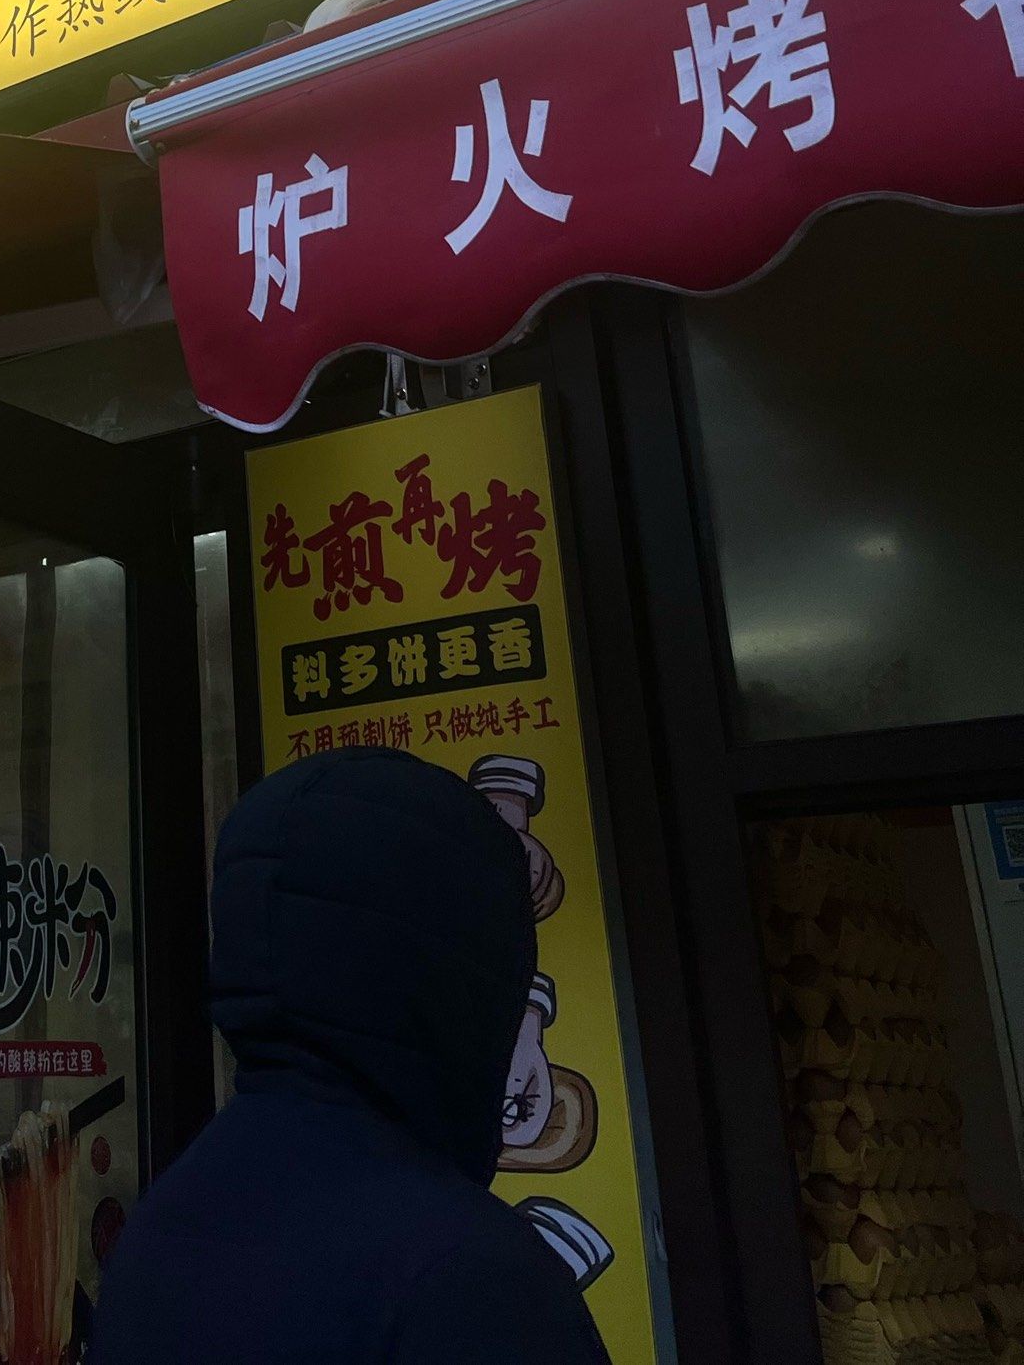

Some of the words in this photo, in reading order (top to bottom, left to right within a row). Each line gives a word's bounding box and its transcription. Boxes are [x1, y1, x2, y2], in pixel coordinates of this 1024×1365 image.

[260, 453, 546, 622] 先煎再烤
[291, 618, 532, 703] 料多饼更香
[422, 697, 560, 745] 只做纯手工
